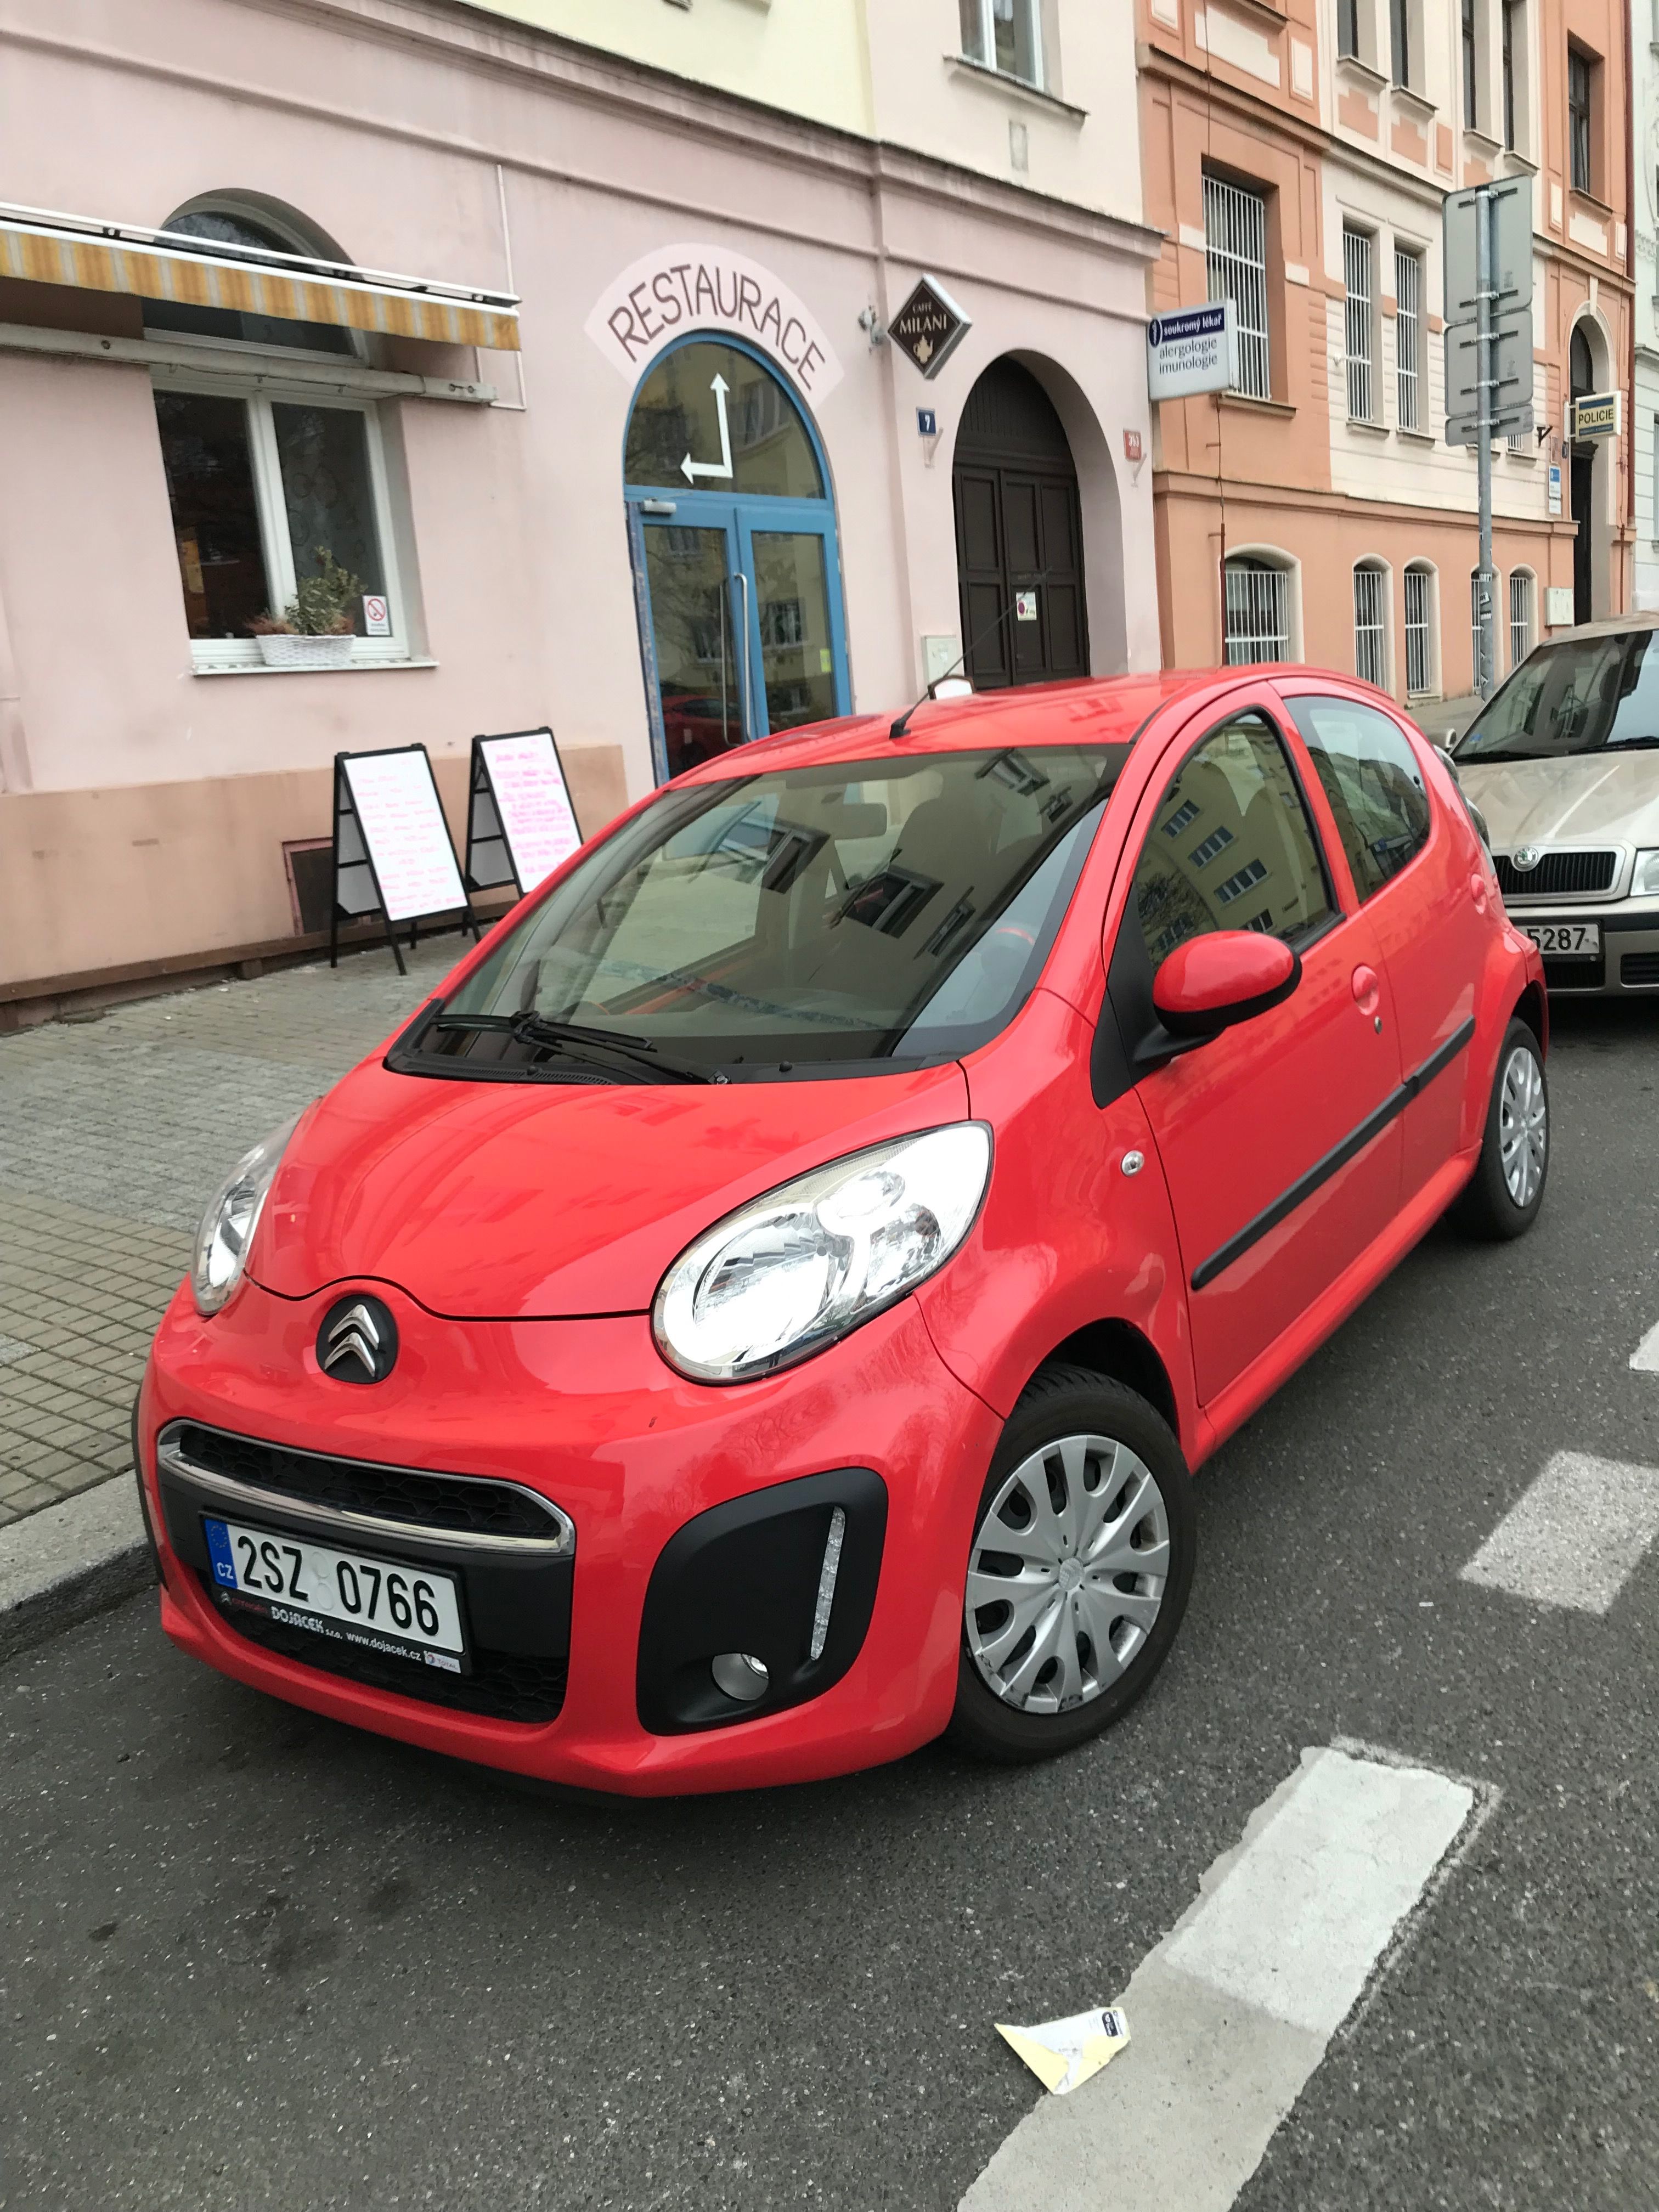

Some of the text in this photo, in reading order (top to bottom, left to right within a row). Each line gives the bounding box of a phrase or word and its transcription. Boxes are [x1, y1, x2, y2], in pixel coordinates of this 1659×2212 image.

[607, 264, 825, 391] RESTAURACE
[900, 313, 947, 335] MILANI
[1164, 313, 1222, 336] soukromý lékař
[1159, 337, 1217, 359] alergologie
[1159, 353, 1218, 375] imunologie
[1578, 408, 1614, 425] POLICIE
[1527, 927, 1587, 951] 5287
[217, 1561, 234, 1580] CZ
[238, 1535, 439, 1637] 2SZ 0766
[346, 1632, 422, 1661] www.dojacek.cz
